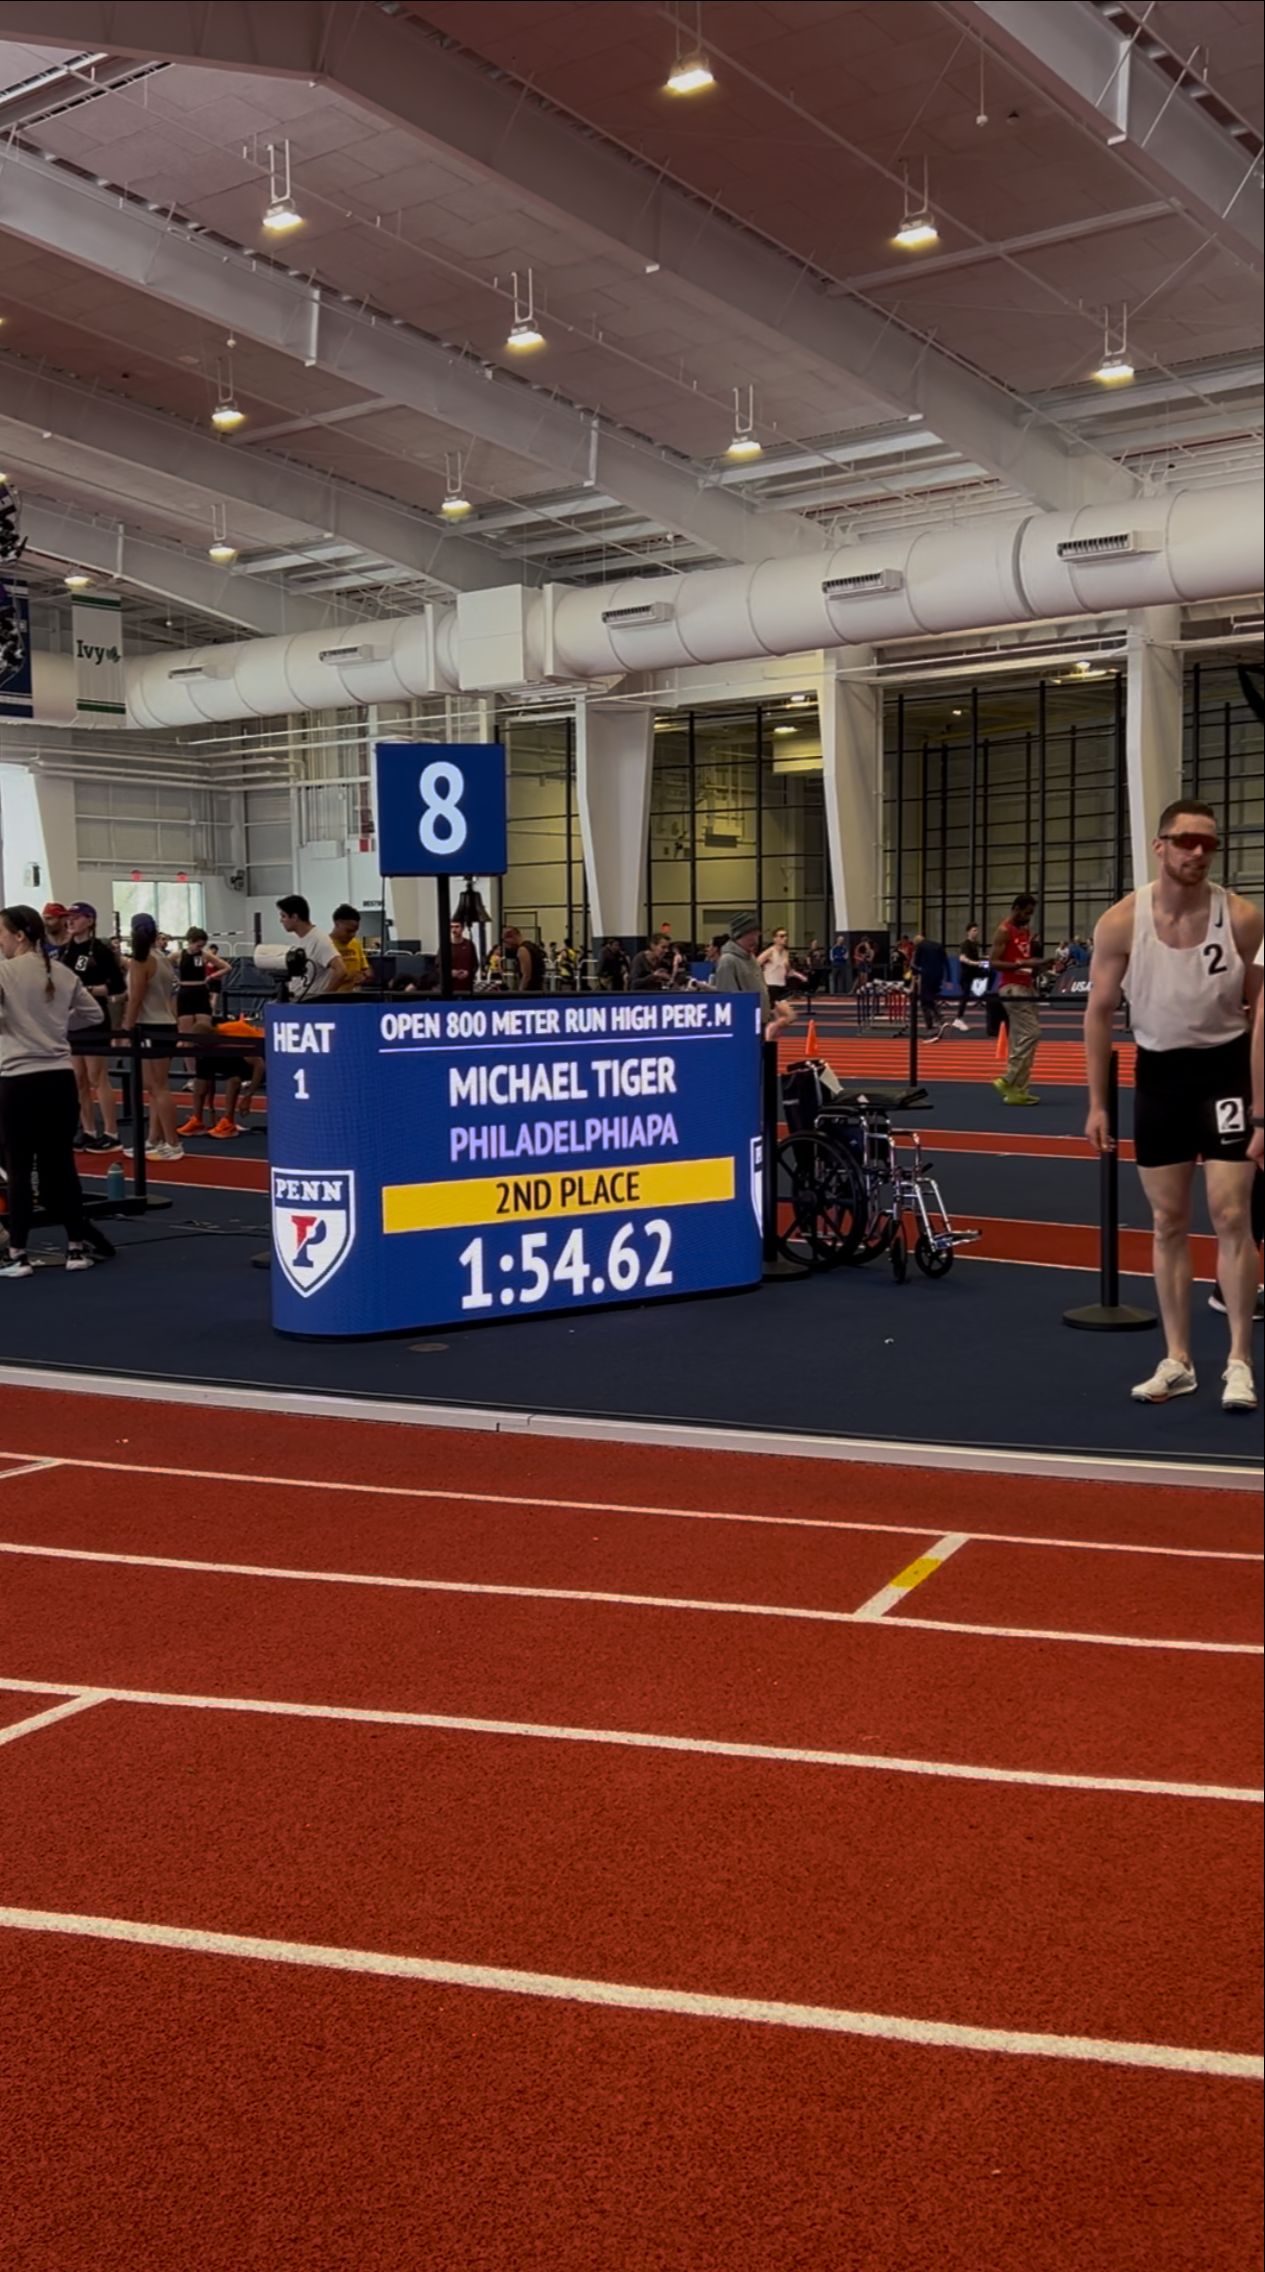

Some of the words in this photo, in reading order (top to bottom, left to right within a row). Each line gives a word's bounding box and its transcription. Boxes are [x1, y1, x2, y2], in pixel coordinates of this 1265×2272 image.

[77, 640, 105, 665] Ivy
[419, 761, 467, 855] 8
[1203, 943, 1228, 975] 2
[273, 1022, 336, 1053] HEAT
[380, 1013, 440, 1040] OPEN
[446, 1010, 486, 1038] 800
[492, 1009, 560, 1036] METER
[565, 1007, 606, 1033] RUN
[611, 1004, 657, 1031] HIGH
[293, 1068, 310, 1100] 1
[450, 1062, 588, 1107] MICHAEL
[591, 1056, 677, 1098] TIGER
[1219, 1101, 1240, 1130] 2
[450, 1113, 679, 1162] PHILADELPHIAPA
[275, 1179, 343, 1202] PENN
[496, 1179, 551, 1214] 2ND
[560, 1171, 640, 1208] PLACE
[459, 1218, 673, 1310] 1:54.62
